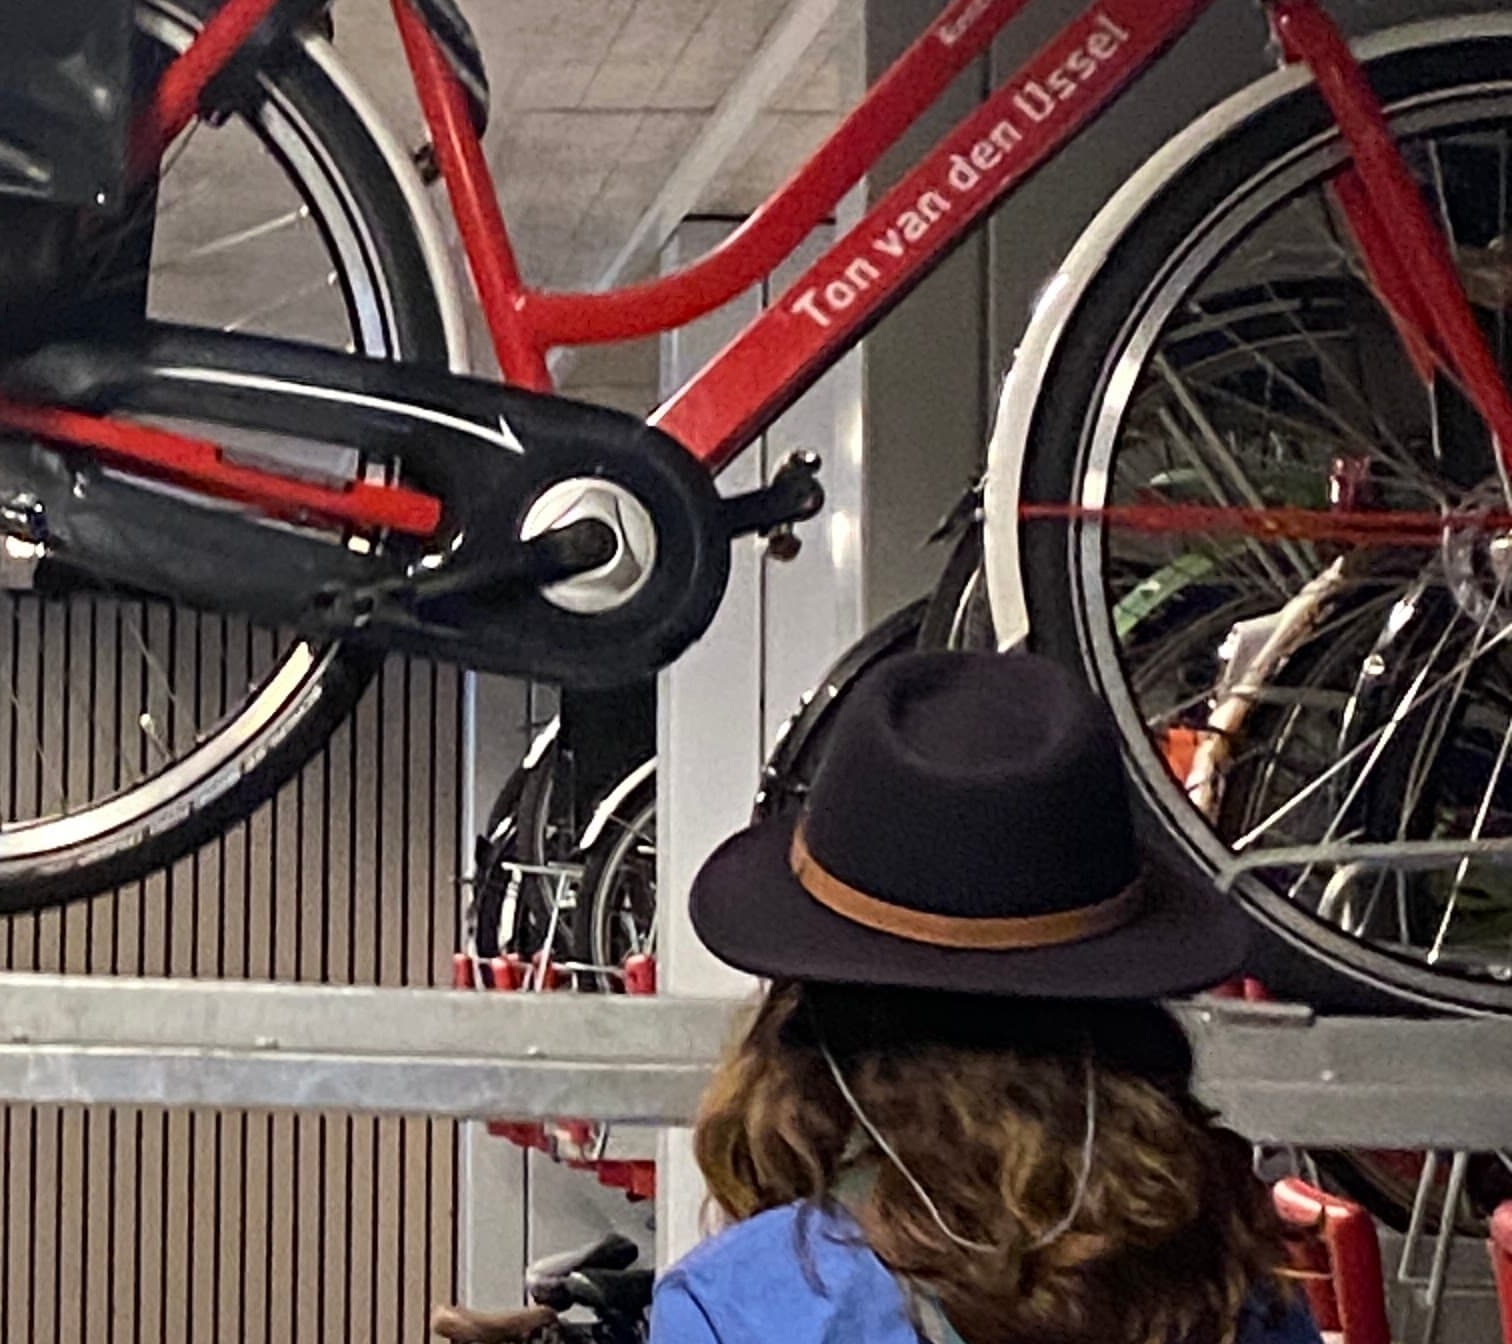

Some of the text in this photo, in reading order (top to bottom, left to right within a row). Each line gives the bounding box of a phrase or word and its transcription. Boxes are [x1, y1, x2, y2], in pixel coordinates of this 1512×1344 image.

[792, 263, 881, 328] Ton
[873, 190, 951, 258] van
[948, 119, 1024, 192] den
